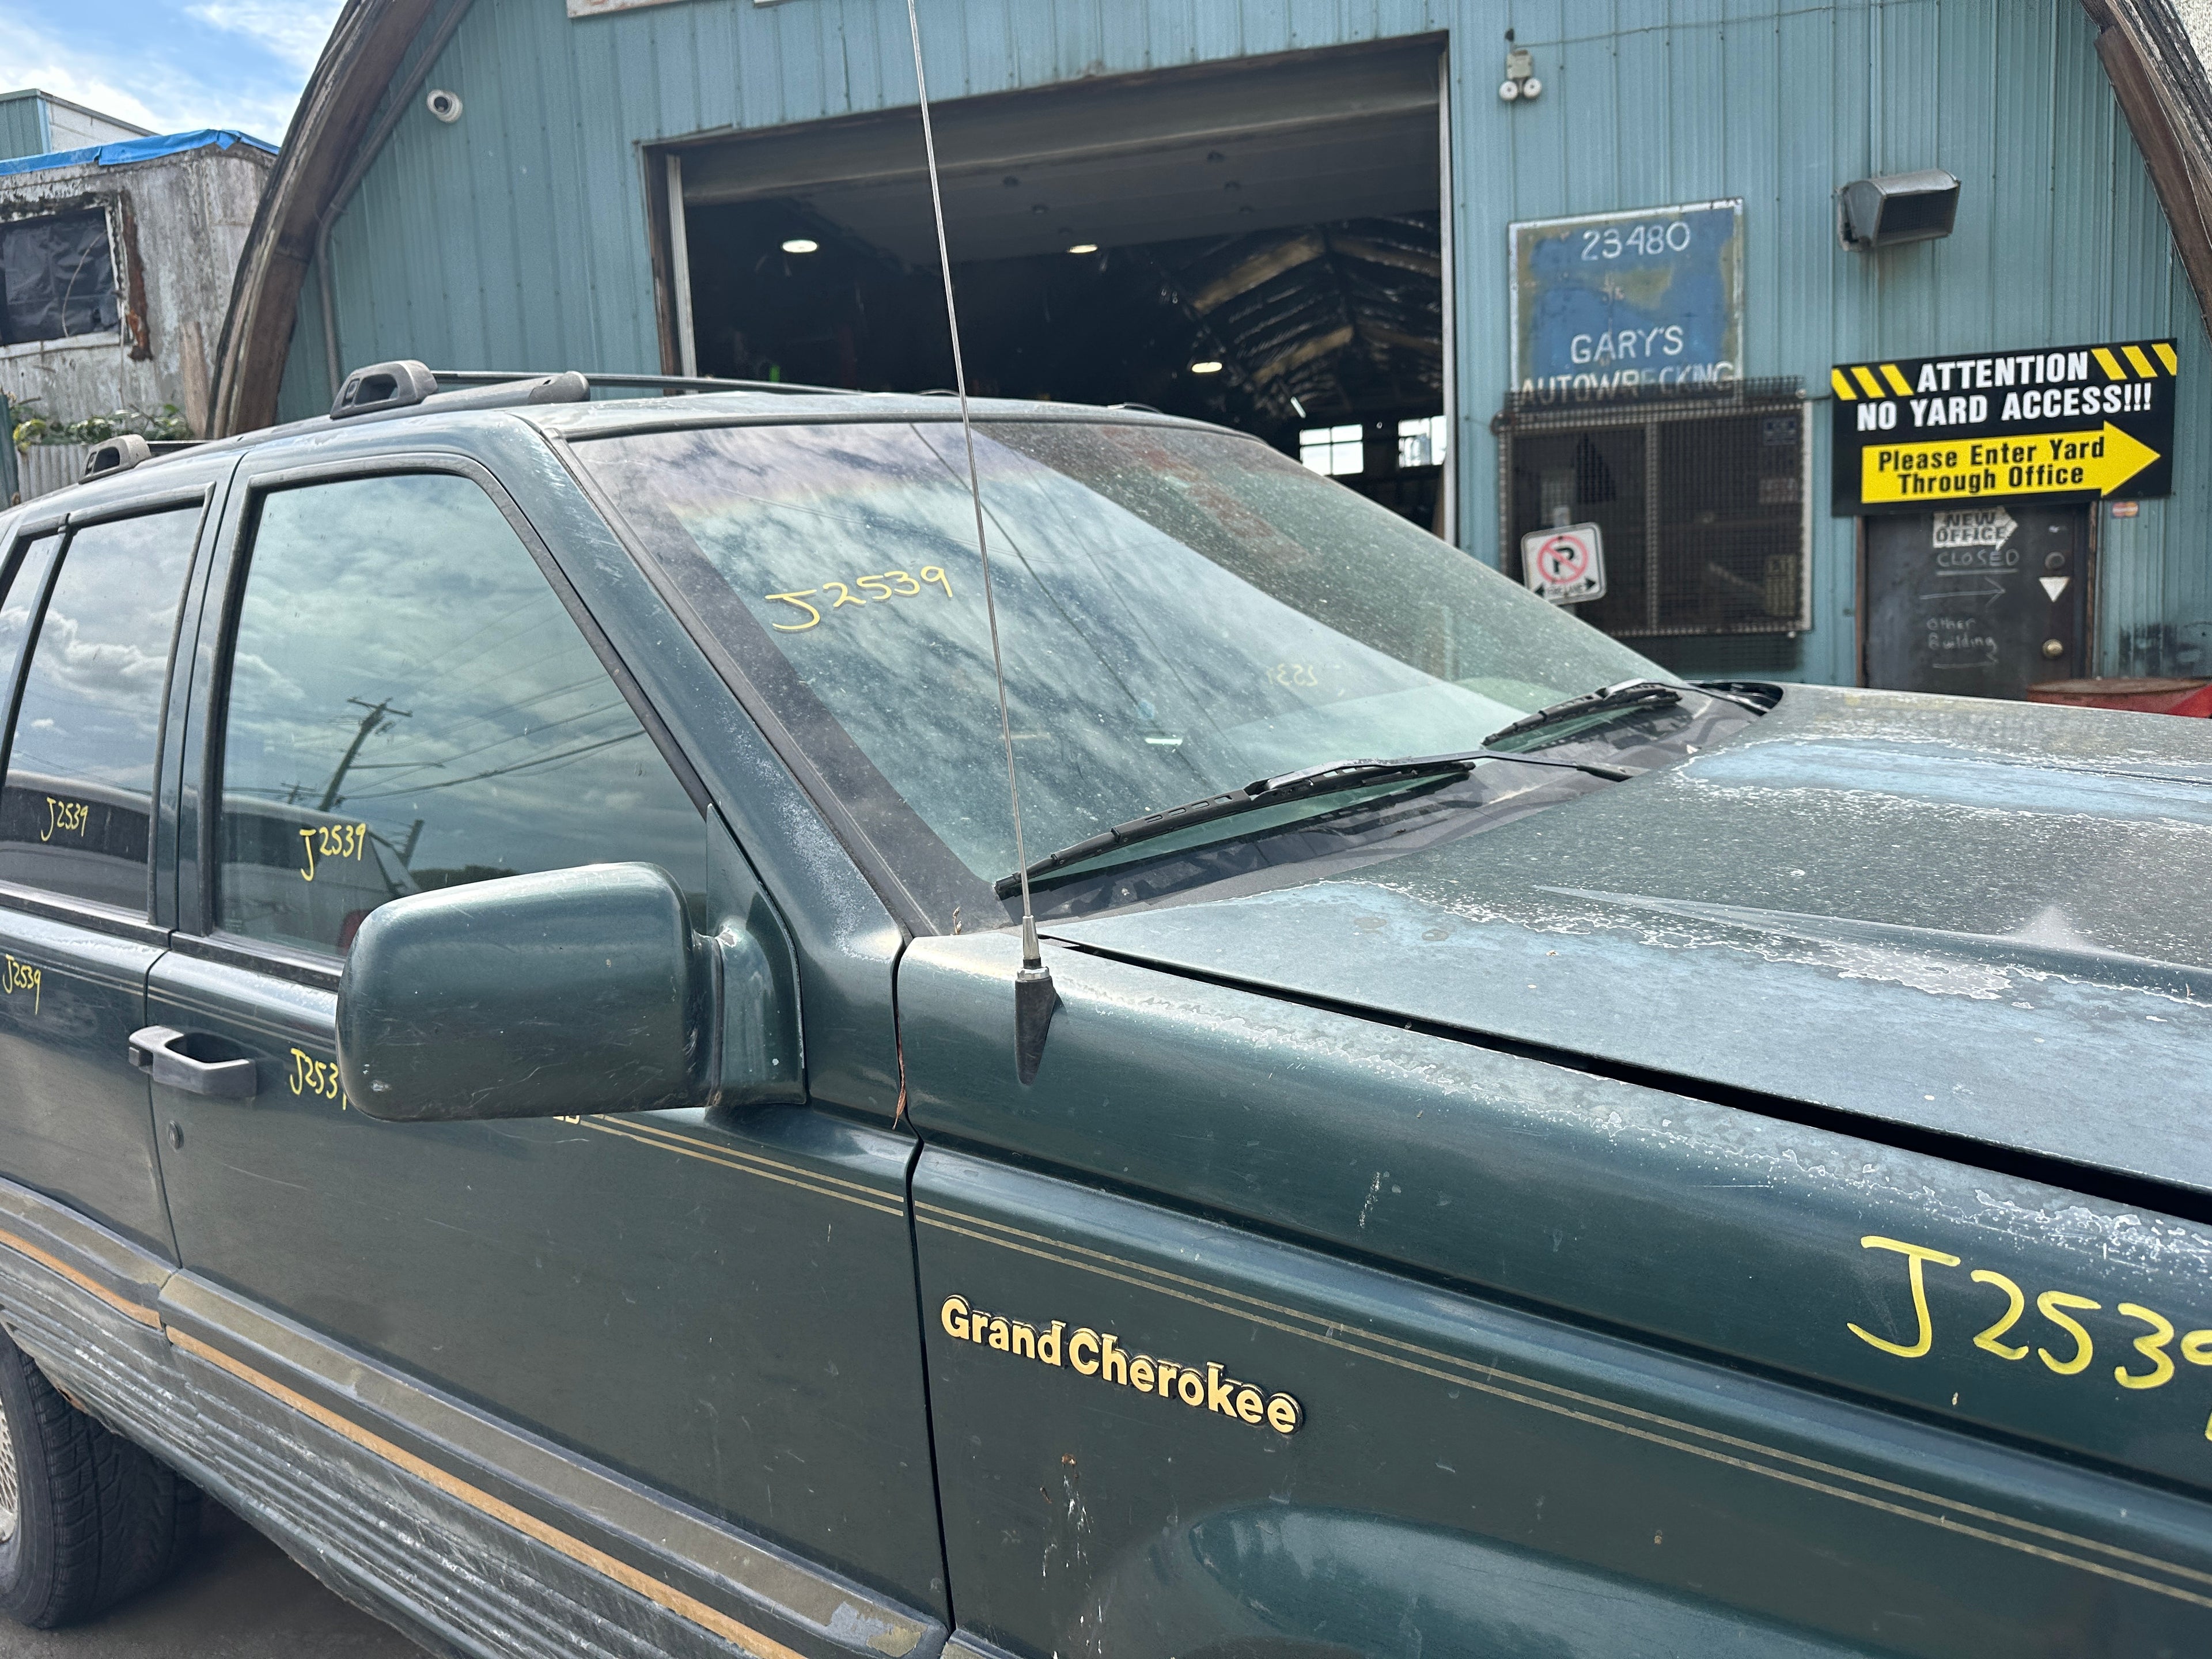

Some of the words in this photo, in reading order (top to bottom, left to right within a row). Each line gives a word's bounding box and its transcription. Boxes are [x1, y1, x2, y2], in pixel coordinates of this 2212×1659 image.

[1581, 221, 1691, 261] 23480
[1570, 325, 1683, 364] GARY'S
[1916, 351, 2088, 393] ATTENTION
[1857, 401, 1896, 431] NO
[1910, 394, 1987, 427] YARD
[2001, 382, 2152, 421] ACCESS!!!
[1878, 448, 1957, 472] Please
[1970, 443, 2037, 466] Enter
[2049, 436, 2105, 459] Yard
[1899, 468, 1996, 495] Through
[2009, 465, 2084, 487] Office
[1946, 512, 1996, 527] NEW
[1937, 548, 2020, 567] CLOSED
[765, 566, 953, 630] J2539
[40, 797, 89, 842] J2539
[299, 823, 367, 881] J2539
[2, 955, 41, 1016] J2539
[941, 1294, 1066, 1367] Grand
[1069, 1327, 1304, 1434] Cherokee
